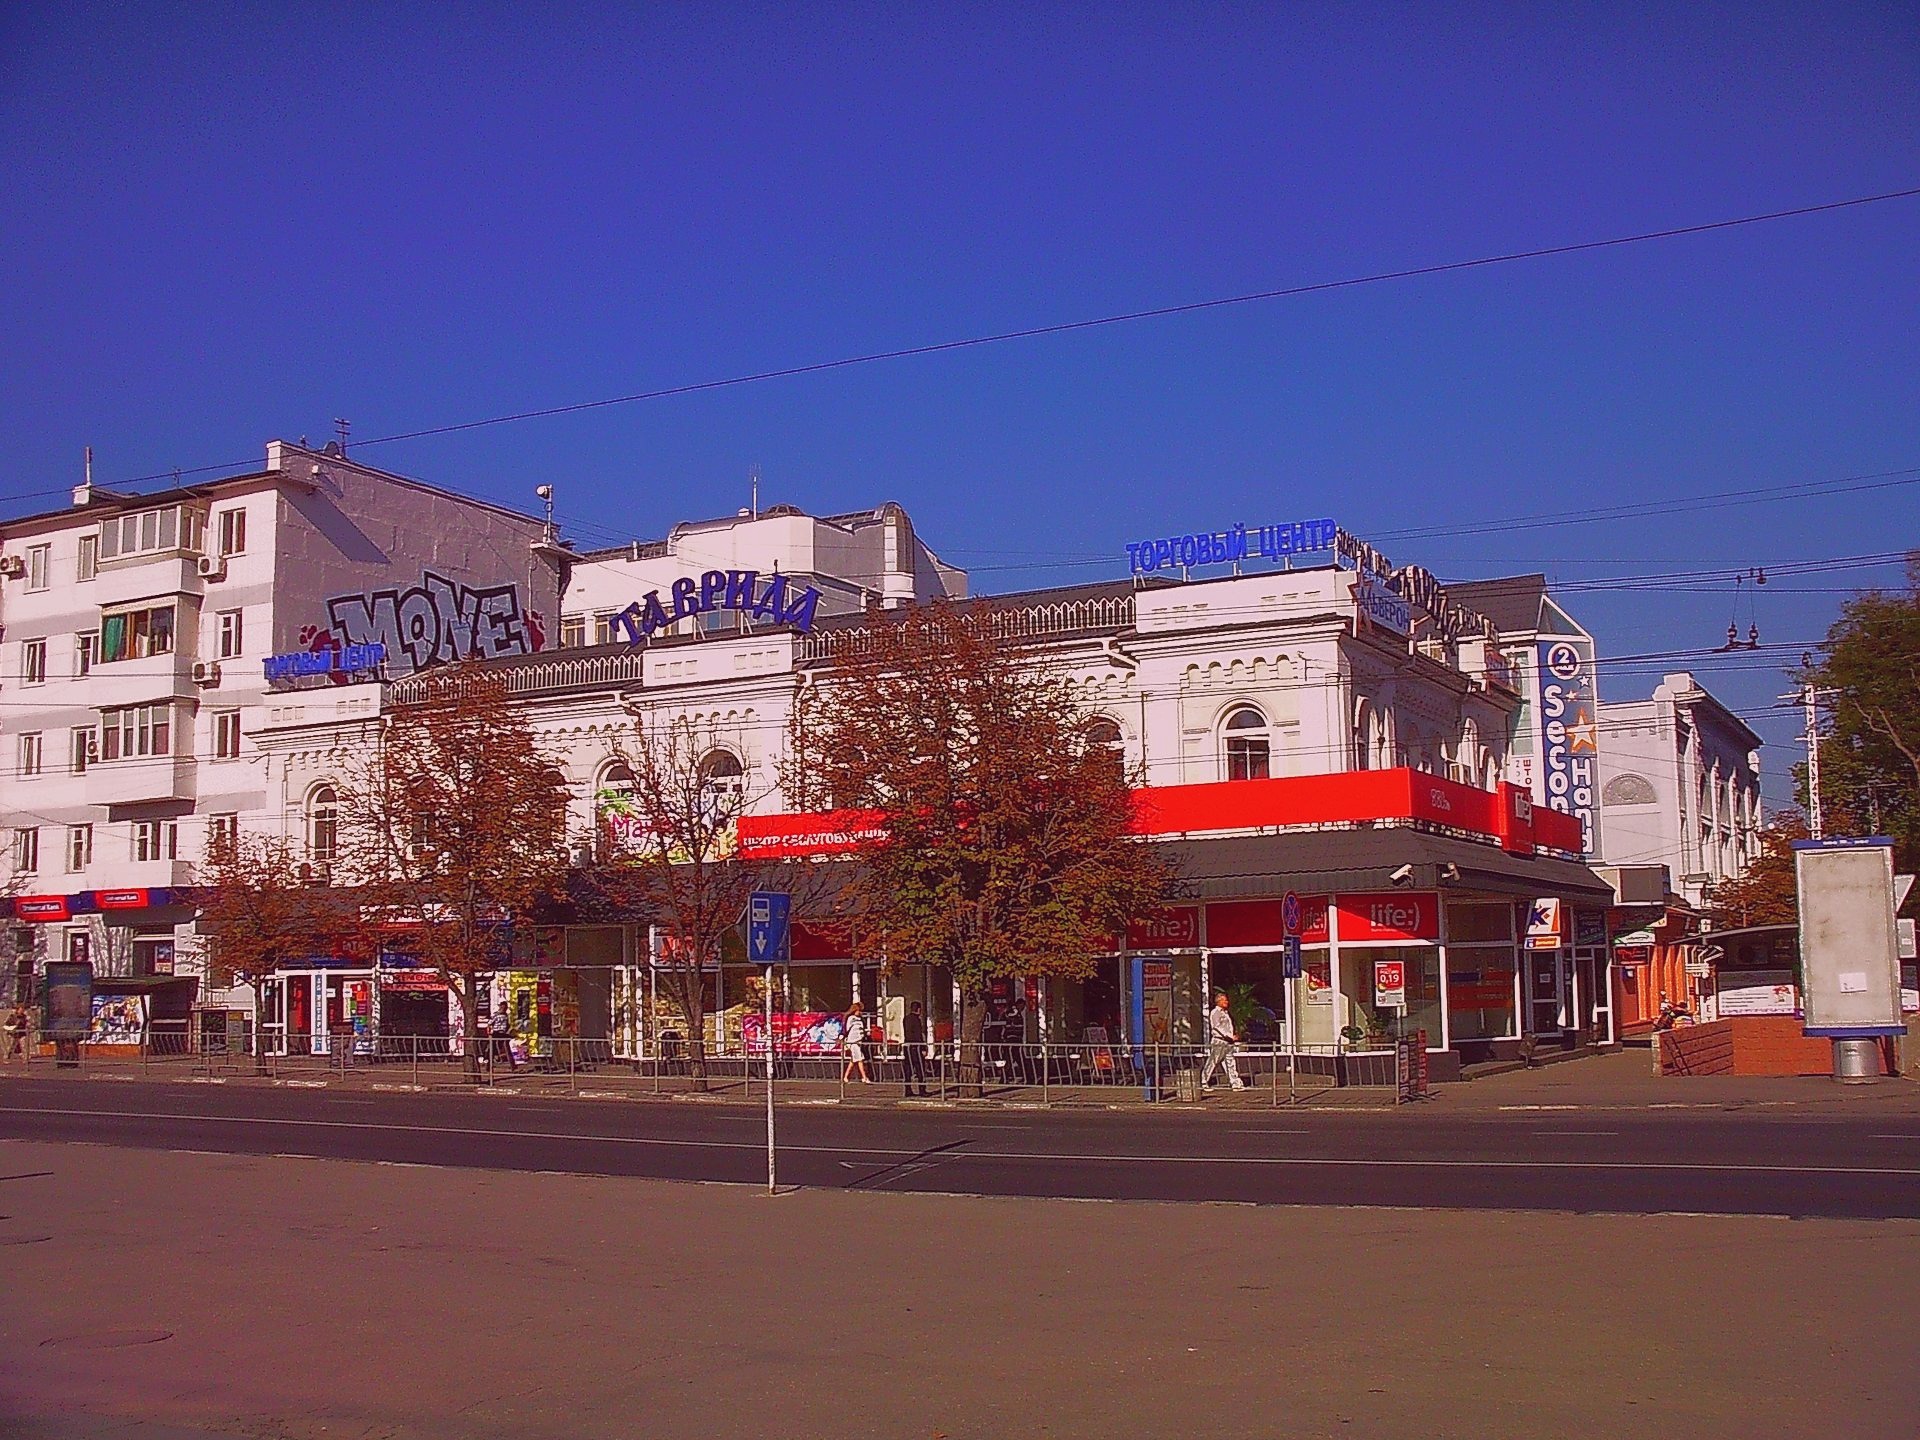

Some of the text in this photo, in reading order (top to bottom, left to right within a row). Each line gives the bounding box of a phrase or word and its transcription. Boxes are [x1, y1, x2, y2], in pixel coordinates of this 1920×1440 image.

[1126, 522, 1248, 574] ТОРГОВЫЙ
[1259, 517, 1337, 563] ЦЕНТР
[608, 569, 823, 648] ТАВРИДА
[1558, 648, 1570, 664] 2
[1544, 685, 1570, 818] Secon
[1523, 759, 1532, 785] ШТО
[1370, 902, 1421, 932] life:)
[1380, 974, 1399, 984] 0,19
